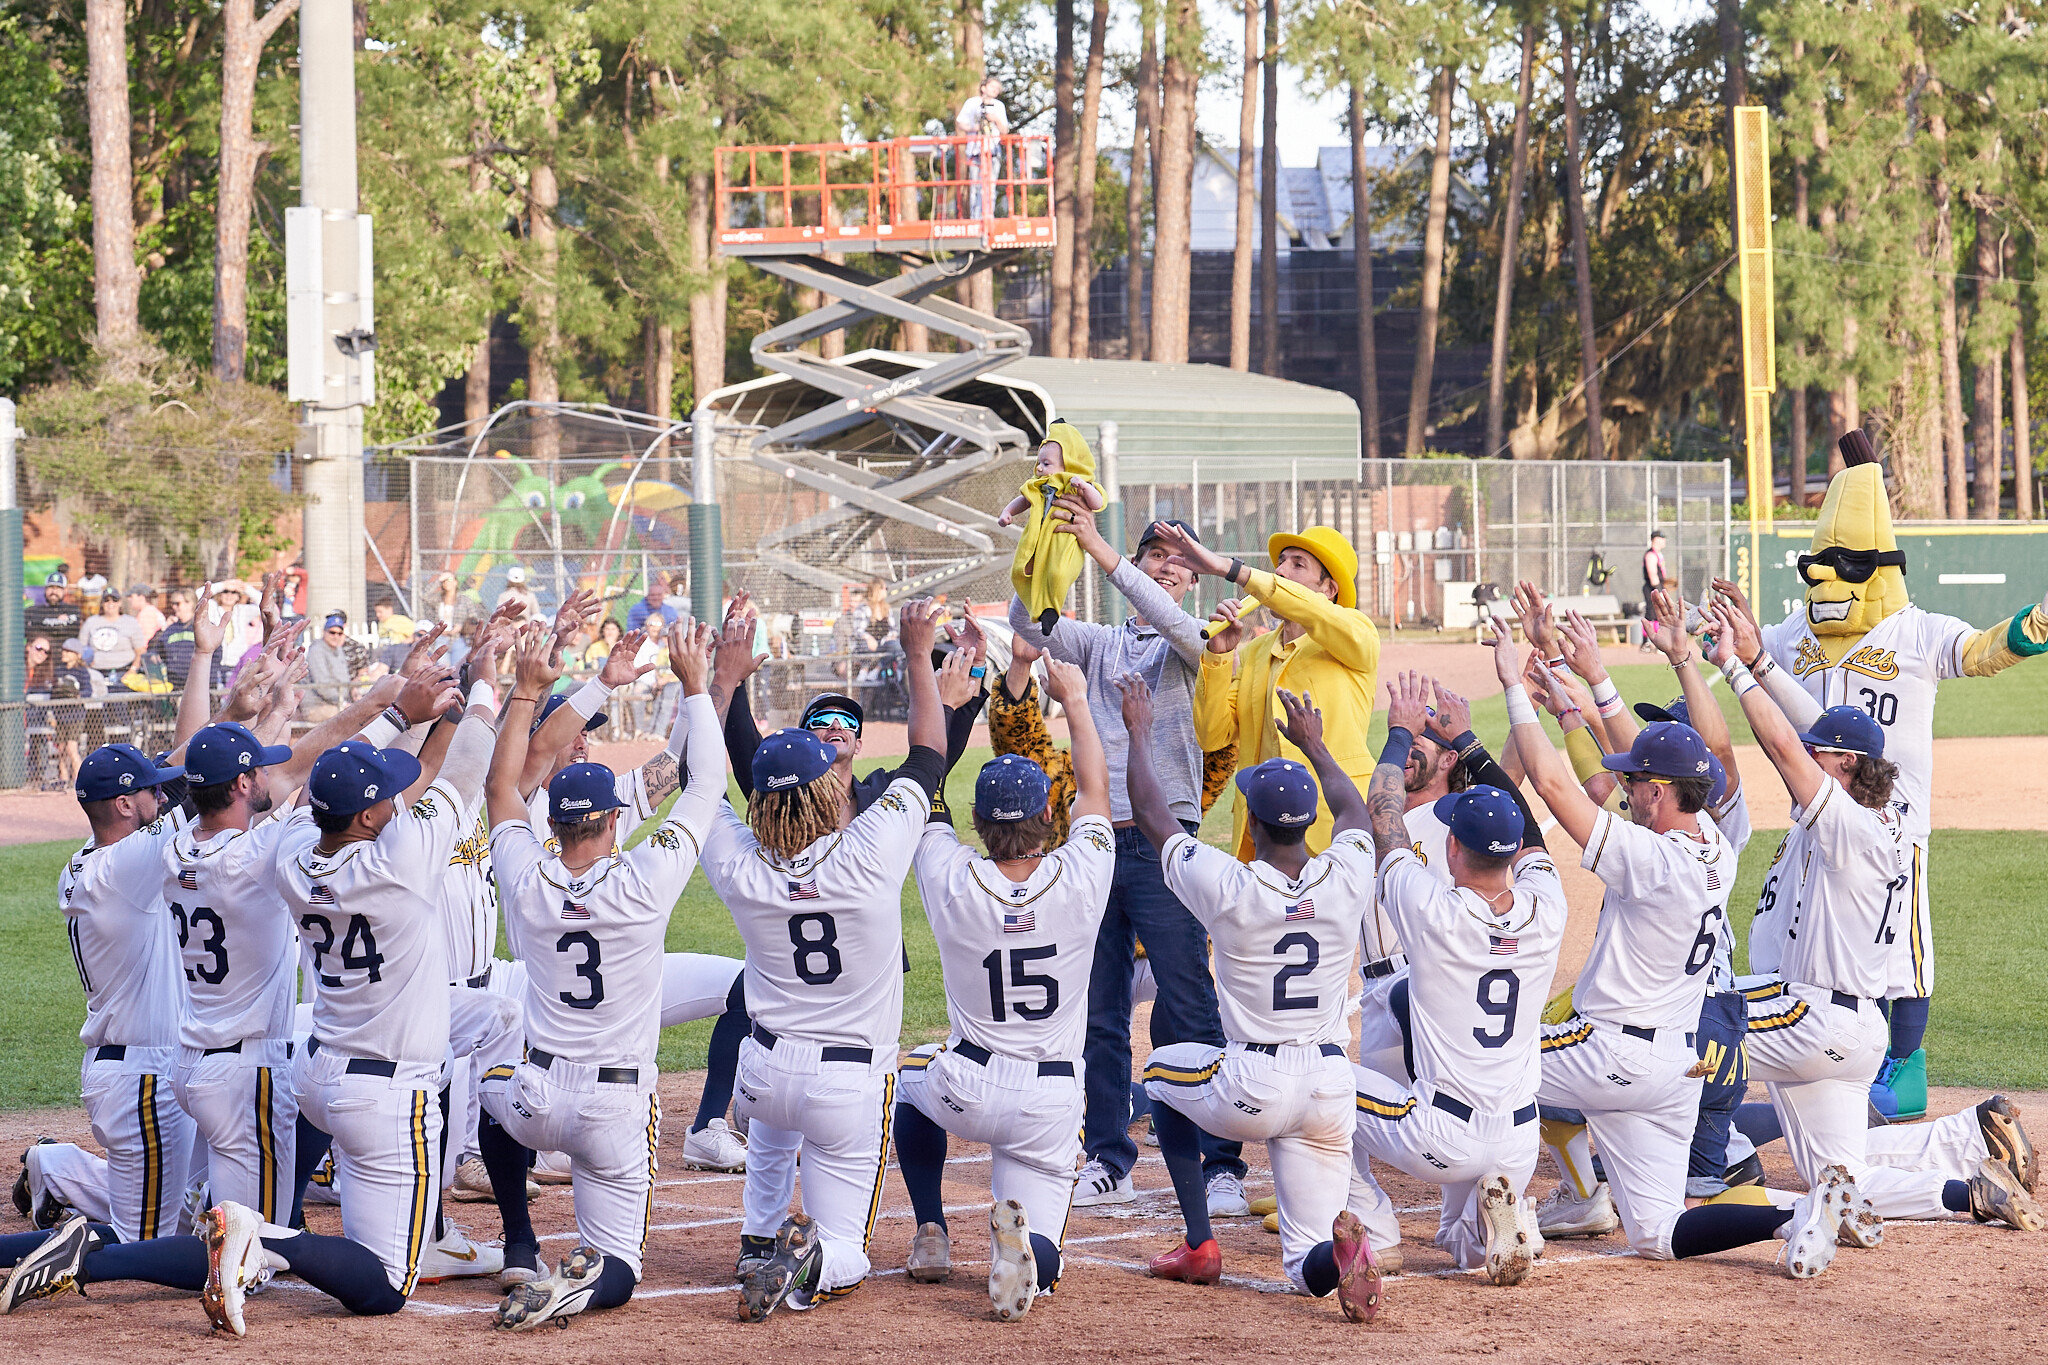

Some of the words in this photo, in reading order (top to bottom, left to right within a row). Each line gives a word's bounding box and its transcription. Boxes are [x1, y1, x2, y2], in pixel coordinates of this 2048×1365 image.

[1859, 687, 1899, 727] 30
[559, 797, 593, 811] Bananas
[299, 912, 385, 988] 24
[556, 930, 605, 1010] 3
[787, 911, 843, 986] 8
[1272, 931, 1320, 1011] 2
[1684, 904, 1723, 977] 6
[982, 943, 1060, 1023] 15
[1472, 968, 1520, 1049] 9
